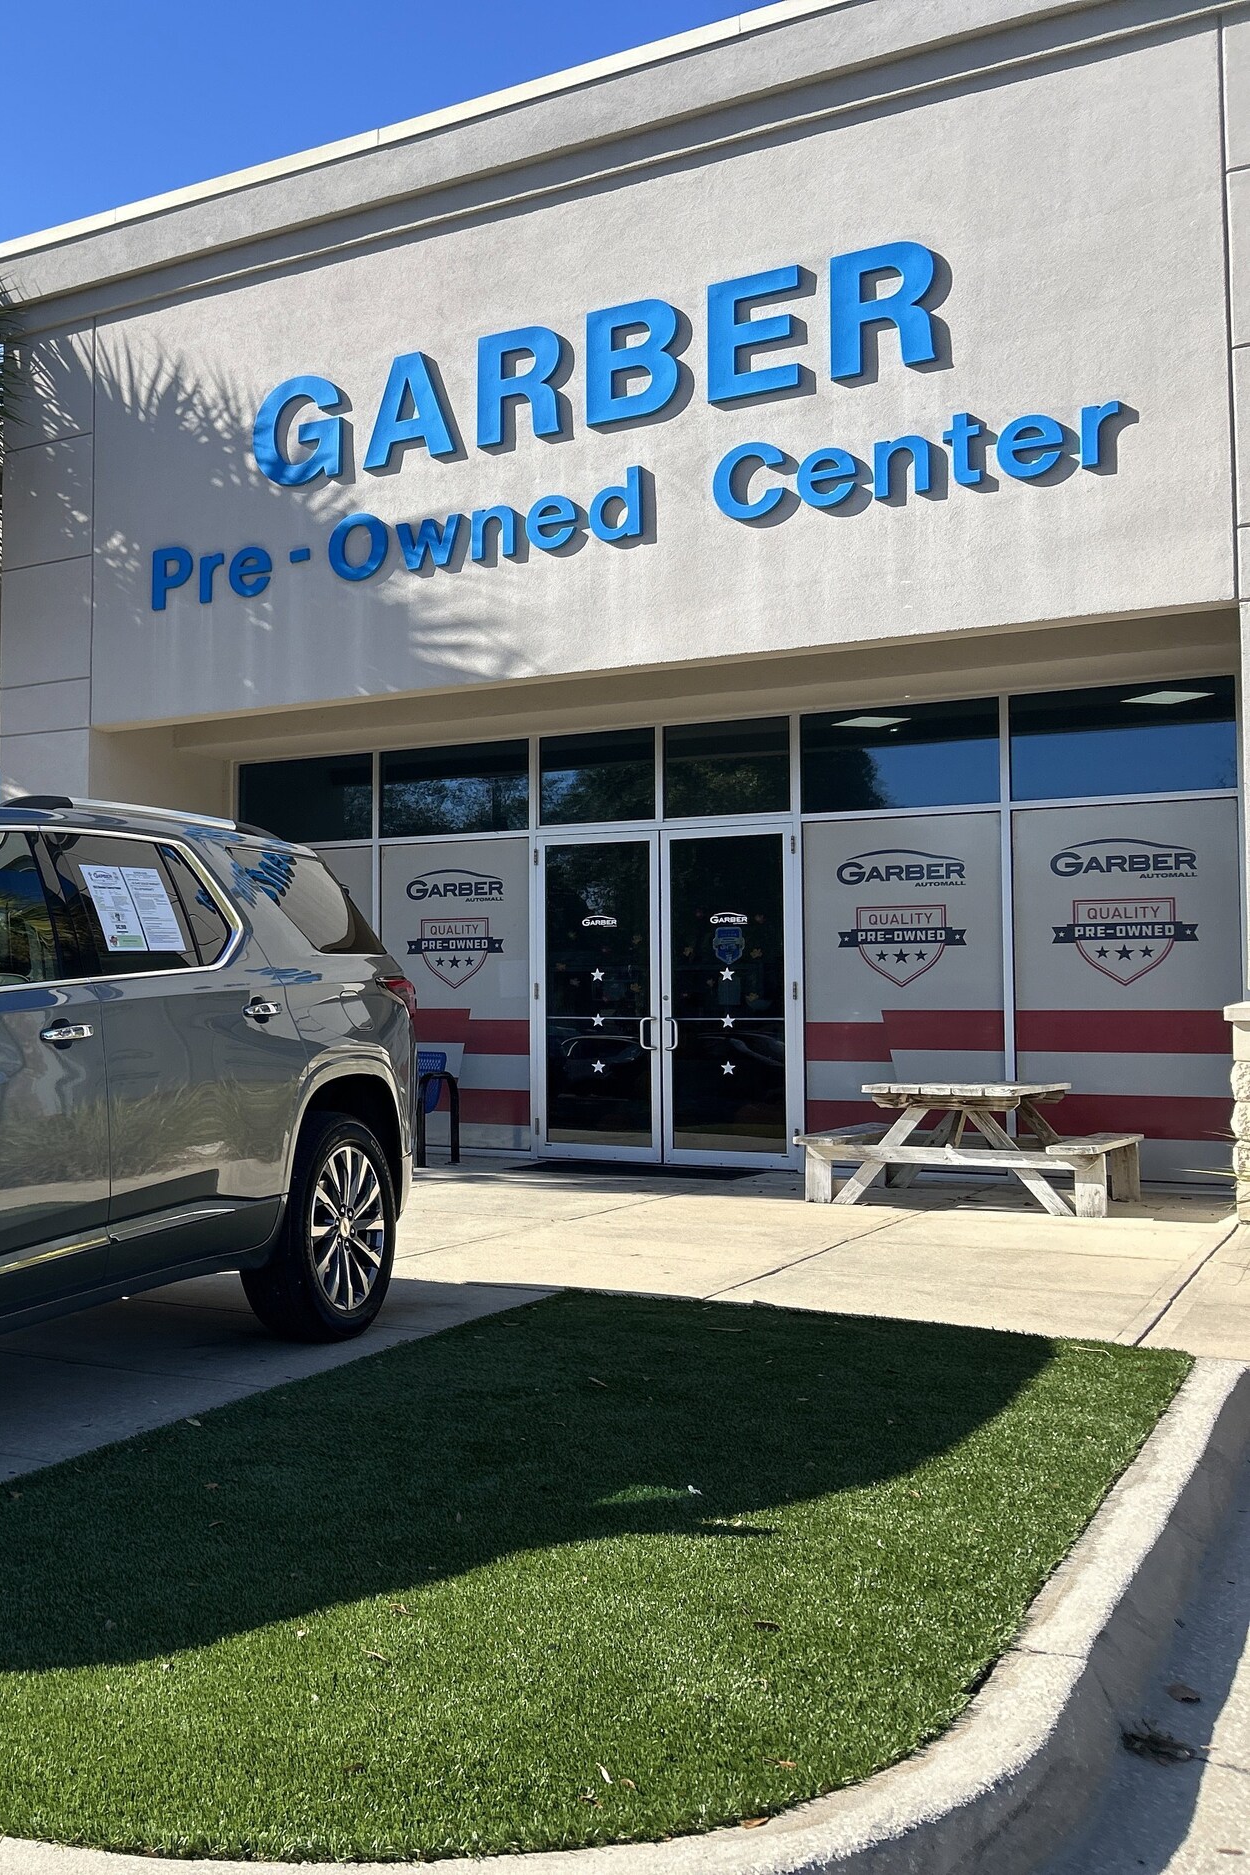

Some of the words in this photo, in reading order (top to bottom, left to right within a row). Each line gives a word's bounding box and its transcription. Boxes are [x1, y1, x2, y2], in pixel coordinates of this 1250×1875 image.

[253, 242, 946, 490] GARBER
[712, 400, 1124, 522] Center
[1050, 851, 1198, 877] GARBER
[836, 862, 966, 886] GARBER
[406, 880, 504, 901] GARBER
[868, 912, 933, 925] QUALITY
[1087, 906, 1161, 919] QUALITY
[430, 924, 479, 936] QUALITY
[857, 930, 946, 942] PRE-OWNED
[1074, 925, 1175, 937] PRE-OWNED
[421, 939, 488, 950] PRE-OWNED
